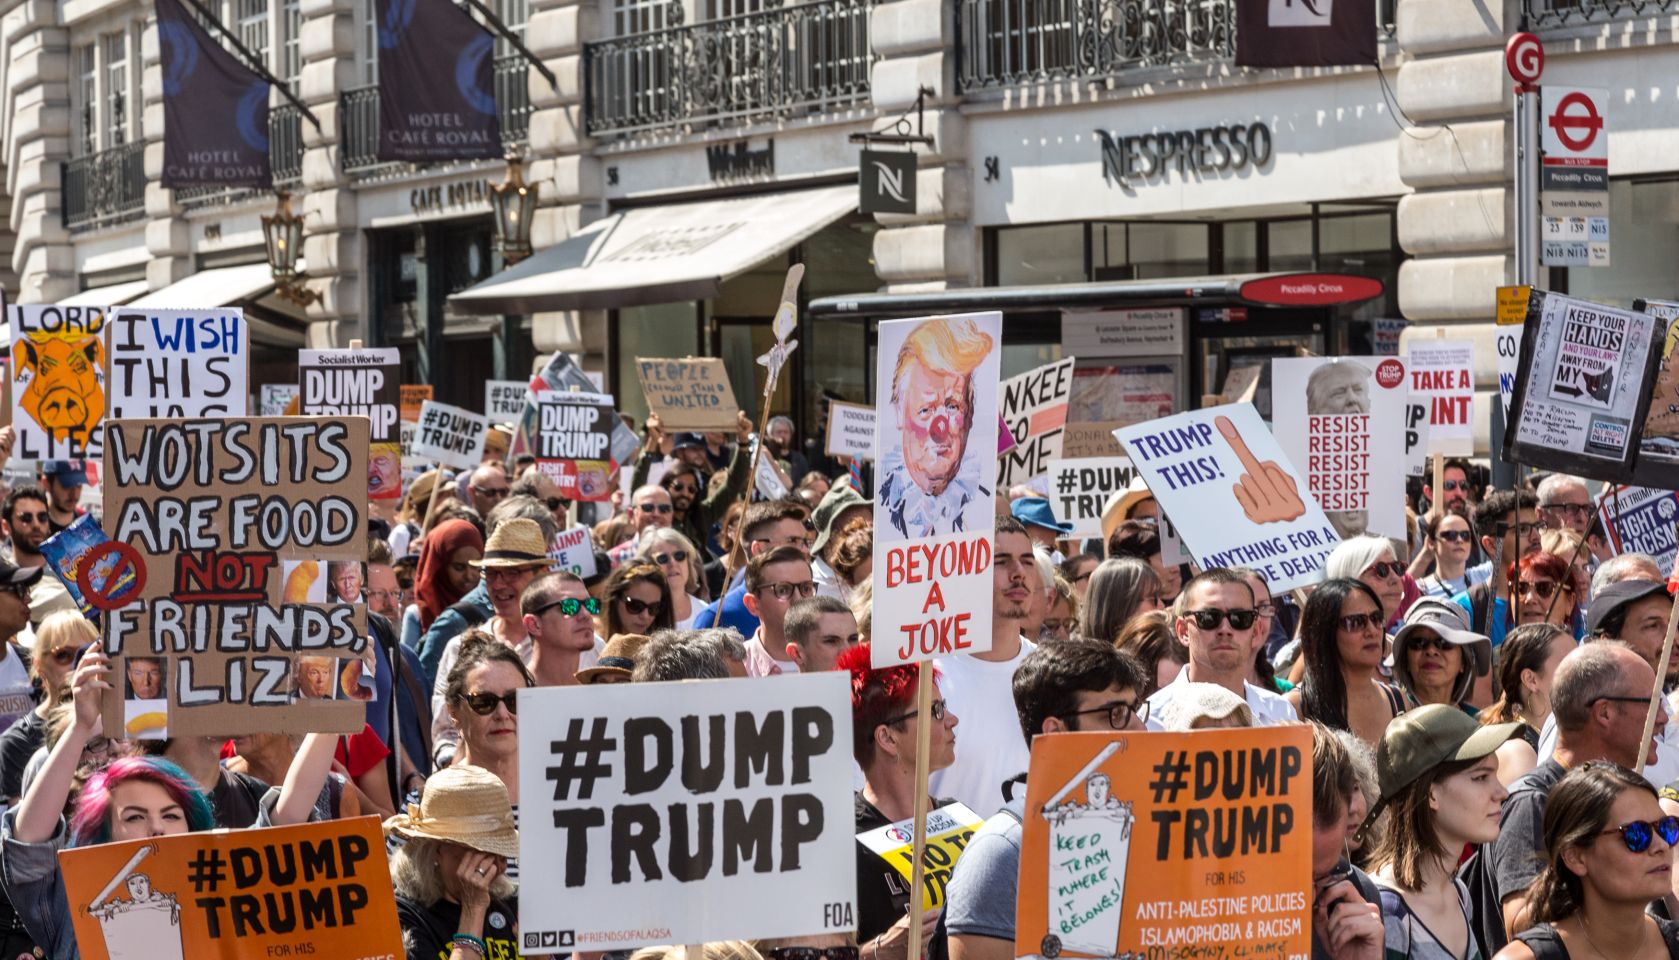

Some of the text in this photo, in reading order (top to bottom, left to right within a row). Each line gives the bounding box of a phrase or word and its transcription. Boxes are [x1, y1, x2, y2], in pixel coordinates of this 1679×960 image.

[1516, 41, 1539, 77] G
[408, 113, 464, 128] HOTEL
[388, 128, 491, 145] CAFÉ ROYAL
[188, 150, 240, 163] HOTEL
[1094, 121, 1273, 191] NESPRESSO
[213, 164, 264, 180] ROYAL
[1551, 173, 1603, 184] Piccadilly Circus
[1551, 199, 1603, 210] towards Aldwych
[1550, 223, 1607, 234] 23 139 N15
[1546, 248, 1564, 258] N18
[1567, 248, 1589, 258] N113
[1280, 283, 1343, 295] Piccadilly Circus
[17, 306, 105, 333] LORD
[1568, 308, 1626, 332] KEEP YOUR
[116, 315, 238, 354] I WISH
[1498, 335, 1516, 357] GO
[1565, 321, 1623, 351] HANDS
[318, 354, 386, 365] Socialist Worker
[1560, 354, 1606, 370] AWAY FROM
[1563, 343, 1619, 361] AND YOUR LAWS
[114, 357, 231, 398] THIS
[641, 361, 710, 381] PEOPLE
[1378, 371, 1402, 379] TRUMP
[1411, 369, 1471, 391] TAKE A
[1557, 364, 1582, 384] MY
[306, 368, 385, 405] DUMP
[491, 386, 527, 399] #DU
[1001, 362, 1072, 418] NKEE
[493, 400, 524, 413] TRU
[661, 394, 720, 408] UNITED
[1430, 396, 1472, 425] INT
[423, 408, 483, 438] #DUMP
[541, 403, 599, 432] DUMP
[843, 424, 875, 436] AGAINST
[1308, 416, 1371, 434] RESIST
[1594, 421, 1625, 433] CONTROL
[21, 424, 103, 459] LIES
[421, 427, 476, 455] TRUMP
[539, 430, 609, 459] TRUMP
[845, 439, 871, 449] TRUMP
[1065, 429, 1113, 444] DONAL
[1129, 423, 1213, 462] TRUMP
[1308, 435, 1371, 453] RESIST
[1591, 434, 1615, 444] DELETE
[108, 420, 352, 491] WOTSITS
[537, 461, 565, 476] FIGHT
[1308, 454, 1371, 472] RESIST
[1156, 455, 1226, 491] THIS!
[1308, 473, 1371, 491] RESIST
[1059, 494, 1110, 521] TRU
[1606, 498, 1630, 516] FIHT
[114, 494, 360, 554] ARE FOOD
[1613, 505, 1658, 542] FIGHT
[549, 530, 585, 552] UMP
[1202, 526, 1338, 571] ANYTHING FOR A
[1622, 520, 1678, 556] RACISM
[175, 551, 278, 592] NOT
[886, 537, 991, 588] BEYOND
[922, 580, 946, 614] A
[104, 597, 369, 657] FRIENDS,
[898, 612, 972, 660] JOKE
[175, 655, 292, 708] LIZ
[545, 706, 834, 801] #DUMP
[1149, 745, 1302, 803] #DUMP
[553, 793, 825, 888] TRUMP
[1151, 803, 1294, 861] TRUMP
[187, 835, 370, 893] #DUMP
[1060, 848, 1112, 876] TRASH
[1058, 867, 1109, 898] WHERE
[1205, 871, 1246, 886] FOR HIS
[194, 883, 370, 939] TRUMP
[824, 902, 854, 928] FOA
[1058, 901, 1075, 917] IT
[1136, 892, 1306, 921] ANTI-PALESTINE POLICIES
[577, 928, 673, 944] @FRIENDSOFALAQSA
[1140, 917, 1302, 946] ISLAMOPHOBIA & RACISM
[266, 943, 316, 958] FOR HIS
